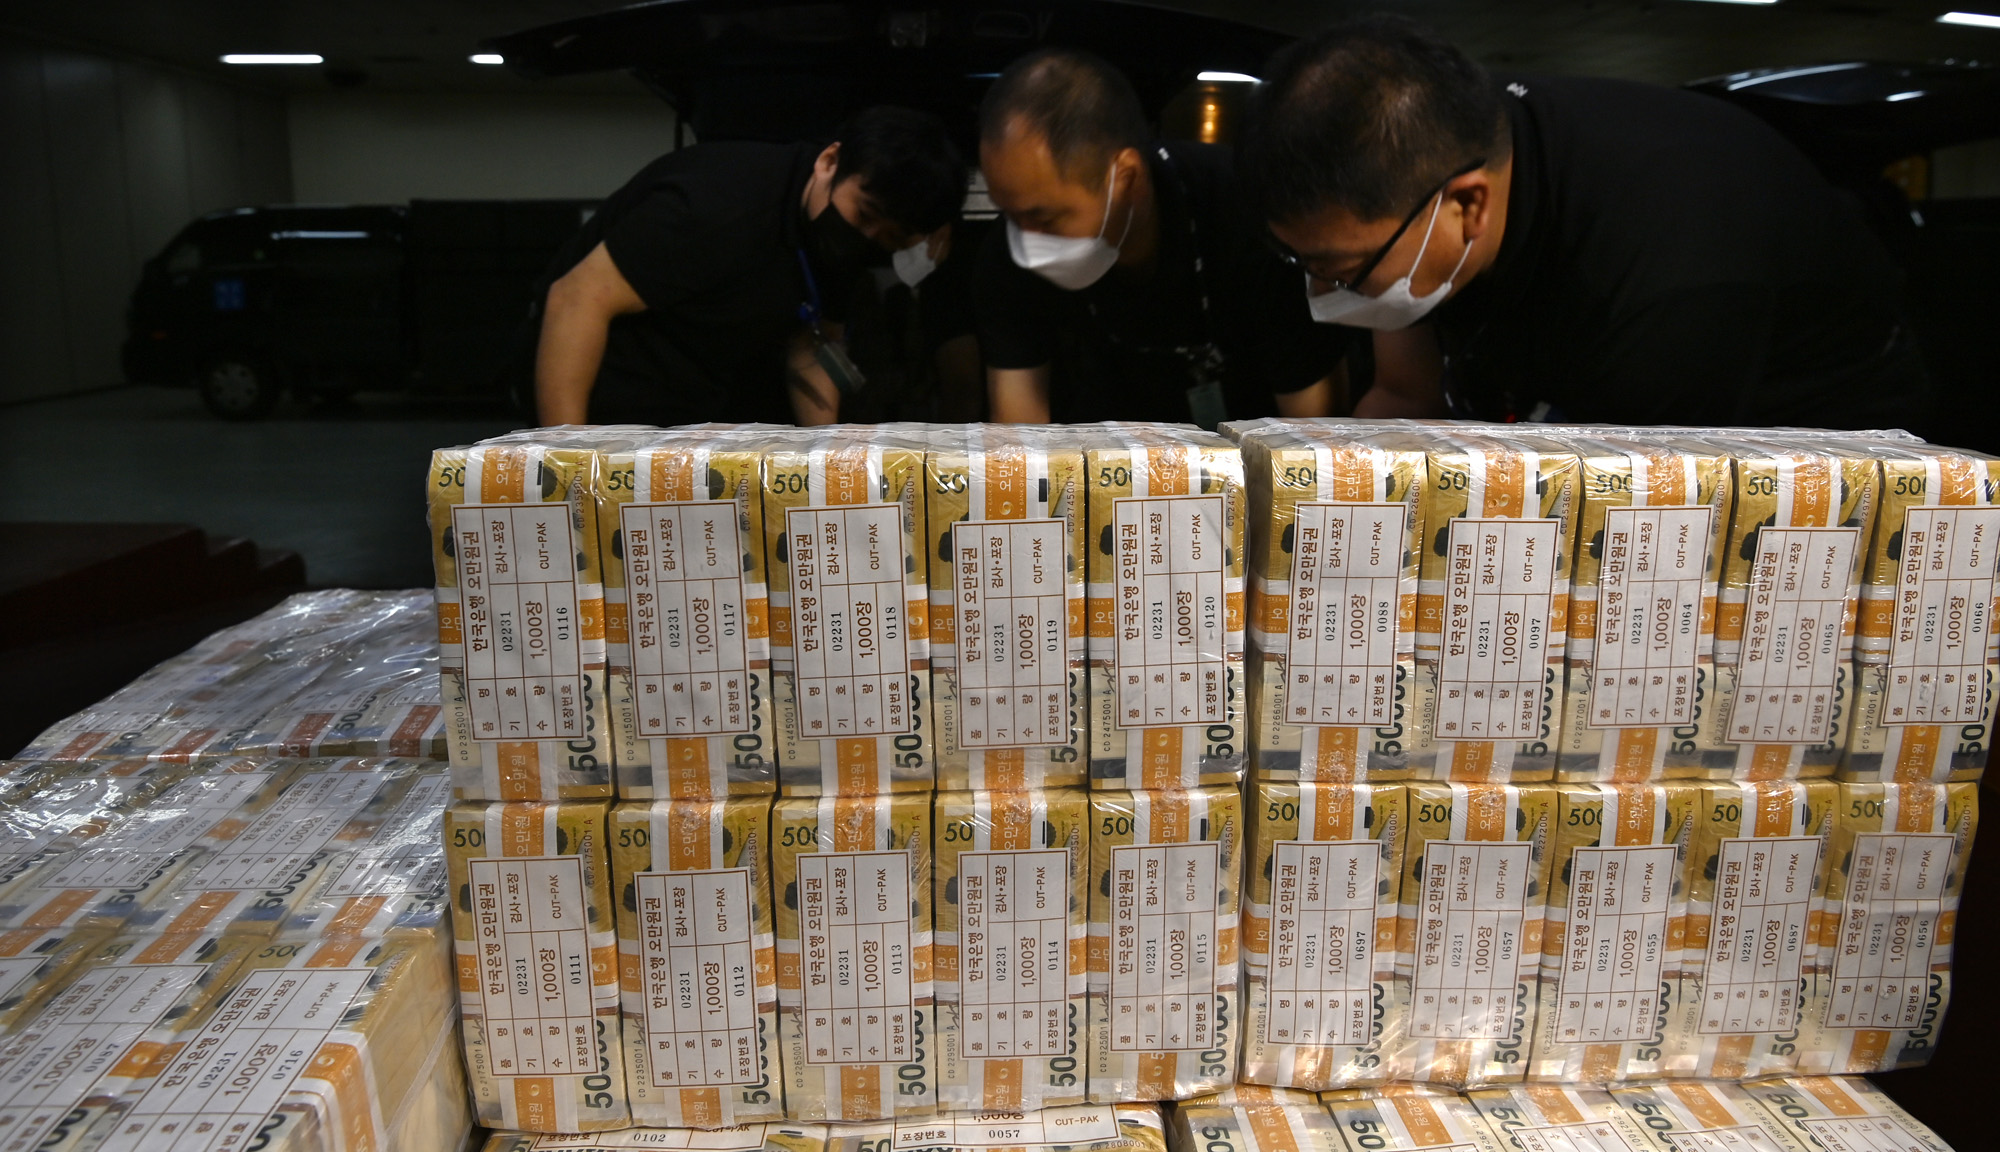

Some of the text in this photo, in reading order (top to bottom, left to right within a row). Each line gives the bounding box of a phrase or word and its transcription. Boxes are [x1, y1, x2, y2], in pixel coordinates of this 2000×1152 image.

[536, 522, 549, 569] CUT-PAK
[704, 520, 716, 566] CUT-PAK
[868, 524, 879, 570] CUT-PAK
[1192, 514, 1200, 560] CUT-PAK
[1370, 522, 1382, 565] CUT-PAK
[1676, 524, 1688, 568] CUT-PAK
[1970, 524, 1983, 567] CUT-PAK
[1033, 538, 1042, 584] CUT-PAK
[1523, 538, 1535, 582] CUT-PAK
[1822, 546, 1836, 589] CUT-PAK
[462, 532, 488, 652] 한국은행 오만원권
[630, 530, 655, 648] 한국은행 오만원권
[796, 534, 818, 652] 한국은행 오만원권
[1122, 524, 1139, 640] 한국은행 오만원권
[1297, 528, 1318, 640] 한국은행 오만원권
[1450, 544, 1472, 656] 한국은행 오만원권
[1605, 533, 1628, 644] 한국은행 오만원권
[1900, 532, 1924, 642] 한국은행 오만원권
[556, 608, 568, 640] 0116
[692, 598, 713, 654] 1,000장
[724, 604, 734, 636] 0117
[886, 607, 896, 638] 0118
[962, 548, 980, 662] 한국은행 오만원권
[1152, 601, 1162, 639] 02231
[1176, 590, 1194, 646] 1,000장
[1205, 597, 1214, 628] 0120
[1325, 604, 1336, 641] 02231
[1350, 594, 1366, 649] 1,000장
[1377, 602, 1388, 632] 0088
[1631, 607, 1643, 644] 02231
[1654, 598, 1671, 651] 1,000장
[1681, 604, 1692, 634] 0064
[1749, 553, 1778, 662] 한국은행 오만원권
[1924, 606, 1937, 642] 02231
[1947, 596, 1964, 649] 1,000장
[1972, 603, 1984, 632] 0066
[500, 612, 513, 651] 02231
[526, 601, 547, 658] 1,000장
[668, 608, 680, 647] 02231
[831, 612, 842, 651] 02231
[856, 602, 875, 658] 1,000장
[994, 624, 1004, 662] 02231
[1018, 614, 1036, 669] 1,000장
[1047, 620, 1057, 651] 0119
[1478, 620, 1490, 657] 02231
[1502, 611, 1519, 665] 1,000장
[1529, 619, 1540, 648] 0097
[1774, 627, 1788, 662] 02231
[1796, 617, 1814, 670] 1,000장
[1822, 624, 1834, 654] 0065
[1272, 694, 1282, 731] 2266001
[877, 869, 886, 911] CUT-PAK
[1036, 867, 1045, 908] CUT-PAK
[1186, 860, 1195, 901] CUT-PAK
[1347, 858, 1357, 898] CUT-PAK
[1496, 860, 1508, 899] CUT-PAK
[1642, 863, 1654, 902] CUT-PAK
[1786, 854, 1798, 893] CUT-PAK
[1917, 850, 1932, 889] CUT-PAK
[549, 875, 561, 918] CUT-PAK
[716, 888, 727, 932] CUT-PAK
[1279, 865, 1296, 968] 한국은행 오만원권
[1425, 864, 1446, 966] 한국은행 오만원권
[1716, 862, 1741, 962] 한국은행 오만원권
[1845, 856, 1874, 955] 한국은행 오만원권
[478, 884, 504, 995] 한국은행 오만원권
[806, 878, 825, 986] 한국은행 오만원권
[967, 876, 983, 982] 한국은행 오만원권
[1119, 870, 1134, 974] 한국은행 오만원권
[1572, 870, 1594, 972] 한국은행 오만원권
[1787, 924, 1798, 951] 0687
[1868, 924, 1883, 955] 02231
[1890, 914, 1910, 962] 1,000장
[1916, 920, 1928, 948] 0656
[645, 898, 667, 1009] 한국은행 오만원권
[892, 945, 902, 974] 0113
[996, 946, 1006, 981] 02231
[1020, 937, 1037, 987] 1,000장
[1048, 942, 1058, 970] 0114
[1146, 939, 1156, 973] 02231
[1170, 929, 1186, 979] 1,000장
[1196, 934, 1207, 963] 0115
[1305, 934, 1316, 968] 02231
[1328, 925, 1344, 975] 1,000장
[1355, 932, 1365, 960] 0697
[1452, 934, 1463, 967] 02231
[1475, 926, 1492, 974] 1,000장
[1502, 932, 1512, 959] 0657
[1597, 938, 1610, 971] 02231
[1620, 930, 1637, 977] 1,000장
[1645, 934, 1657, 961] 0655
[1741, 929, 1754, 962] 02231
[1762, 920, 1780, 967] 1,000장
[516, 958, 528, 994] 02231
[539, 948, 560, 1001] 1,000장
[569, 954, 581, 984] 0111
[733, 966, 744, 996] 0112
[838, 950, 849, 985] 02231
[863, 940, 881, 992] 1,000장
[304, 982, 339, 1019] CUT-PAK
[680, 972, 691, 1008] 02231
[704, 962, 724, 1015] 1,000장
[162, 987, 263, 1088] 한국은행 오만원권
[197, 1051, 238, 1088] 02231
[224, 1043, 278, 1096] 1,000장
[271, 1050, 303, 1080] 0716
[633, 1133, 666, 1143] 0102
[902, 1129, 1020, 1142] 포장번호 0057
[1055, 1115, 1099, 1126] CUT-PAK
